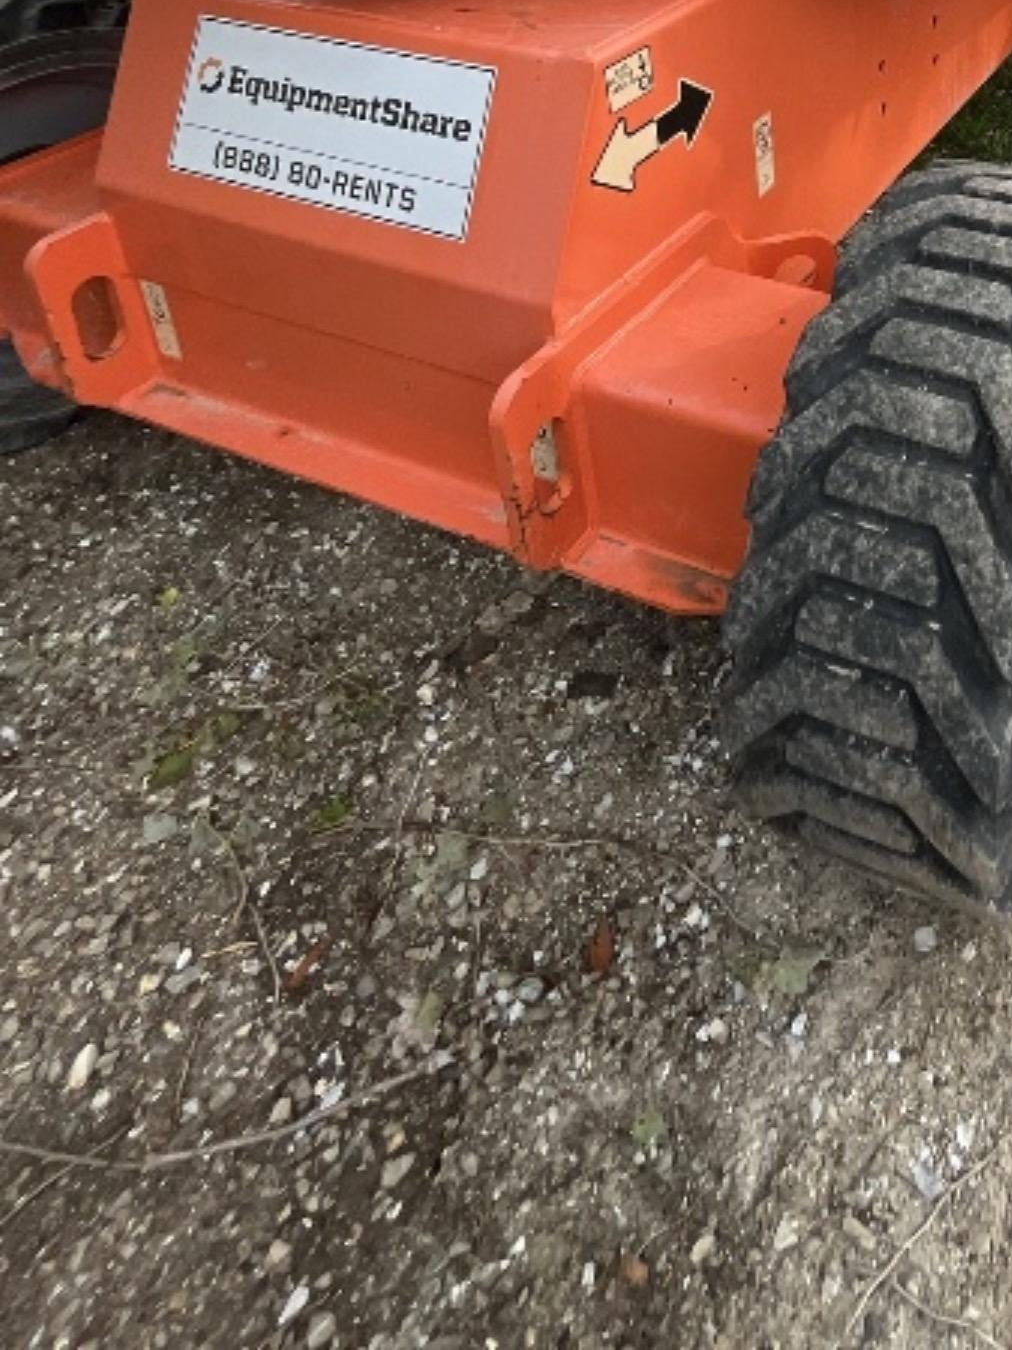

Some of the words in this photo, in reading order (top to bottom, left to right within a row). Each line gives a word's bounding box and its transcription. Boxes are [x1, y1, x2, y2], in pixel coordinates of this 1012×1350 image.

[227, 65, 473, 142] EquipmentShare
[212, 140, 281, 182] (888)
[286, 161, 417, 214] 80-RENTS
